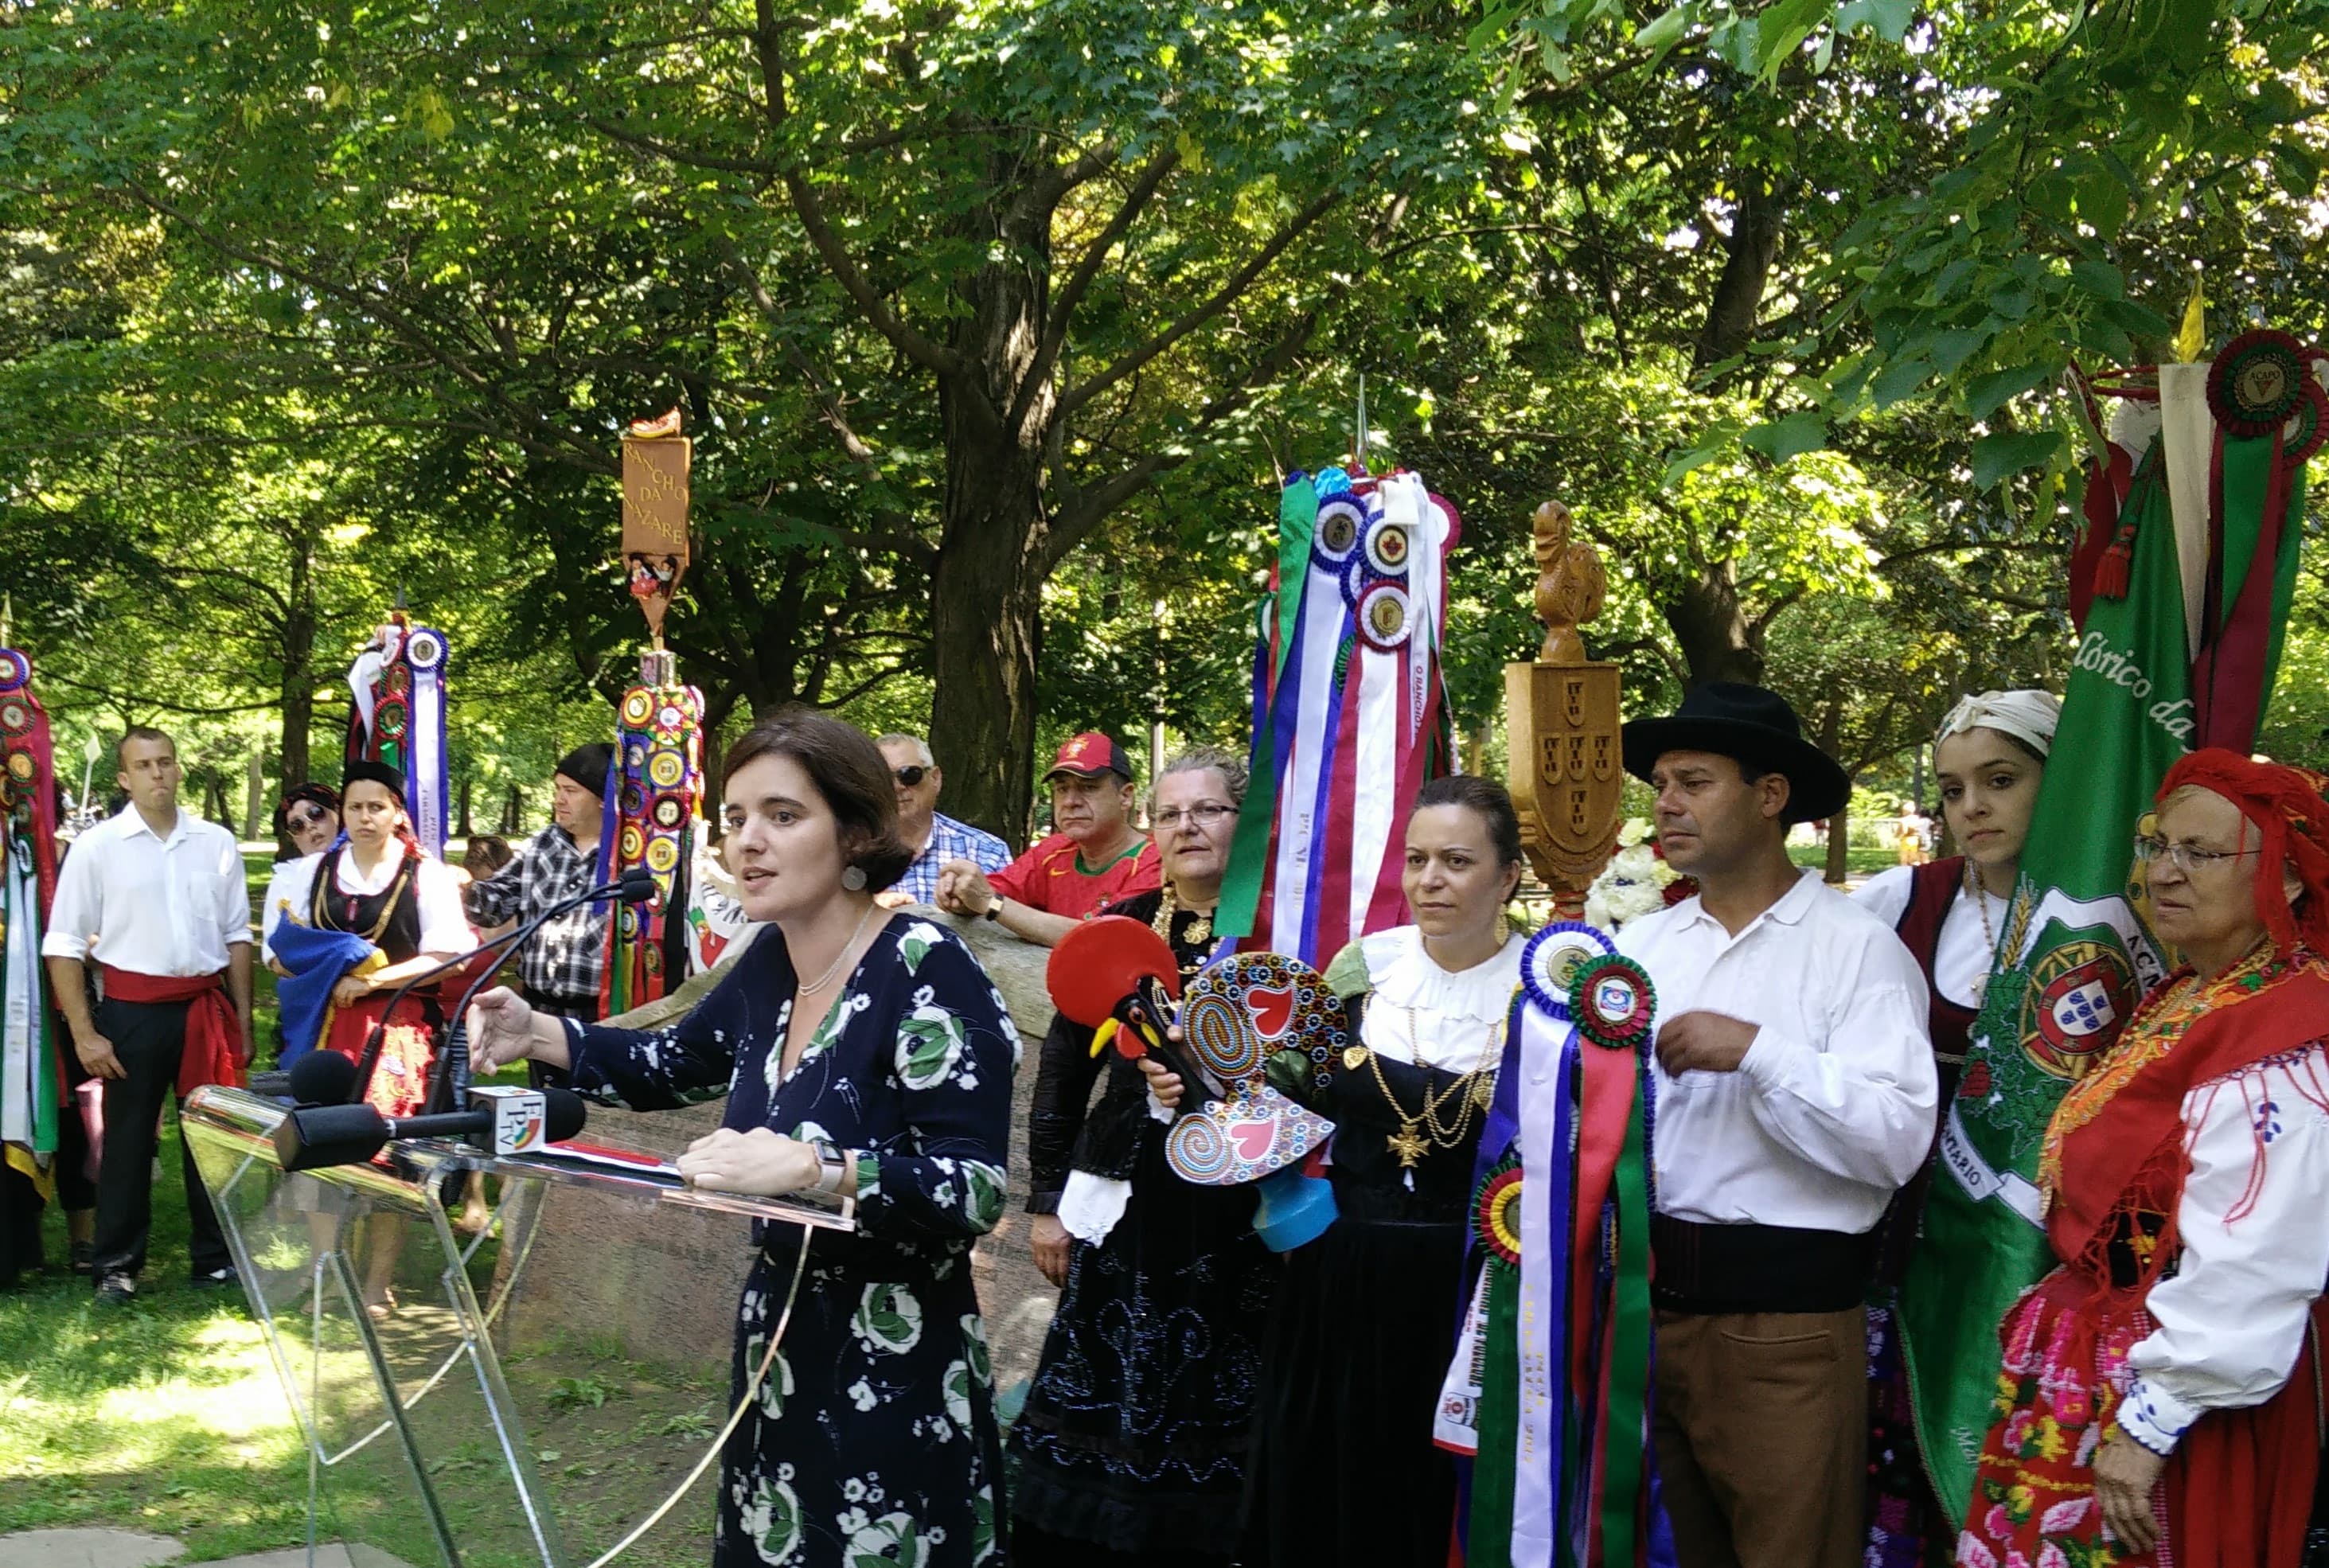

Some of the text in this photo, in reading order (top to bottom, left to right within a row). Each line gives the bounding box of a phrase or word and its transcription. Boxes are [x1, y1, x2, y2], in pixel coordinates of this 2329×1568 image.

[2250, 369, 2281, 380] ACAPO
[623, 443, 689, 501] RANCHO
[639, 486, 663, 501] DA
[2149, 698, 2194, 739] da
